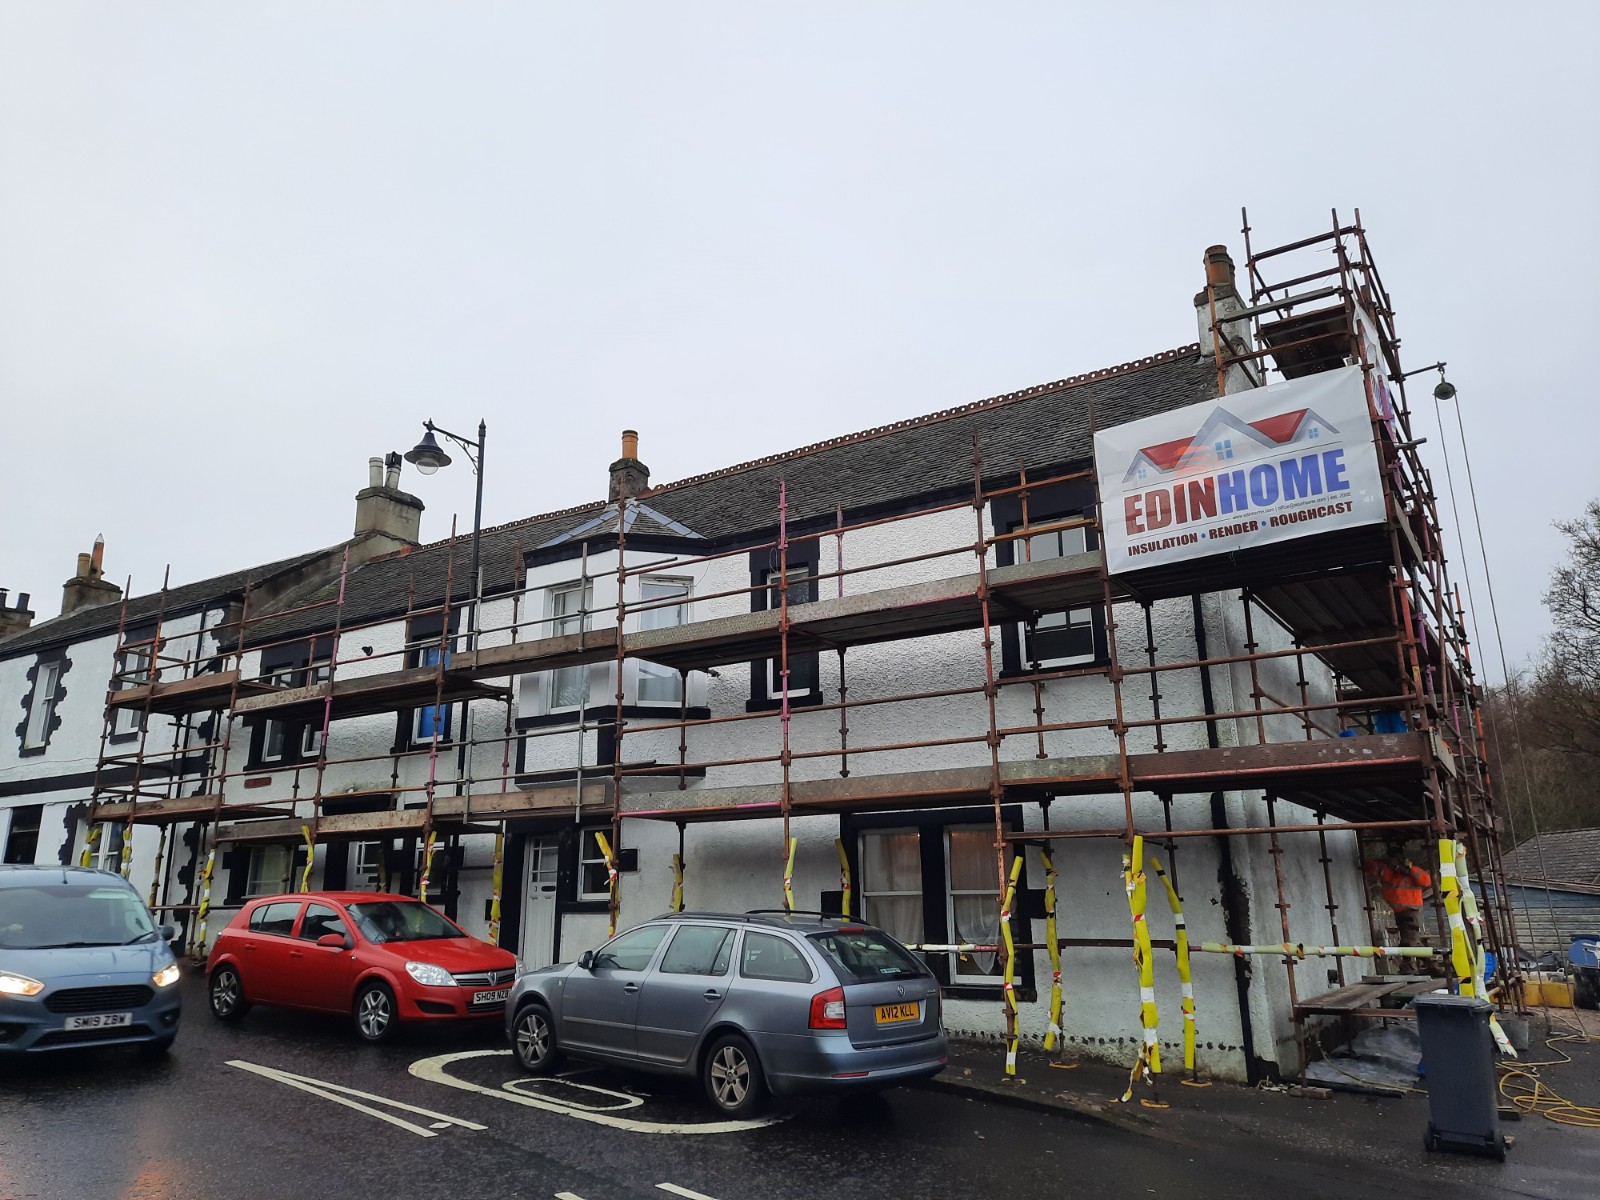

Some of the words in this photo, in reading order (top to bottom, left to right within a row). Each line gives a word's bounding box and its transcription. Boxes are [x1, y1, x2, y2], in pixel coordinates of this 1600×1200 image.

[1124, 448, 1350, 537] EDINHOME
[1127, 532, 1199, 557] INSULATION
[1208, 520, 1259, 540] RENDER
[1269, 500, 1353, 528] ROUGHCAST
[475, 991, 495, 1002] SH09
[103, 1013, 126, 1026] ZBW
[881, 1006, 899, 1020] AV12
[900, 1005, 914, 1017] KLL
